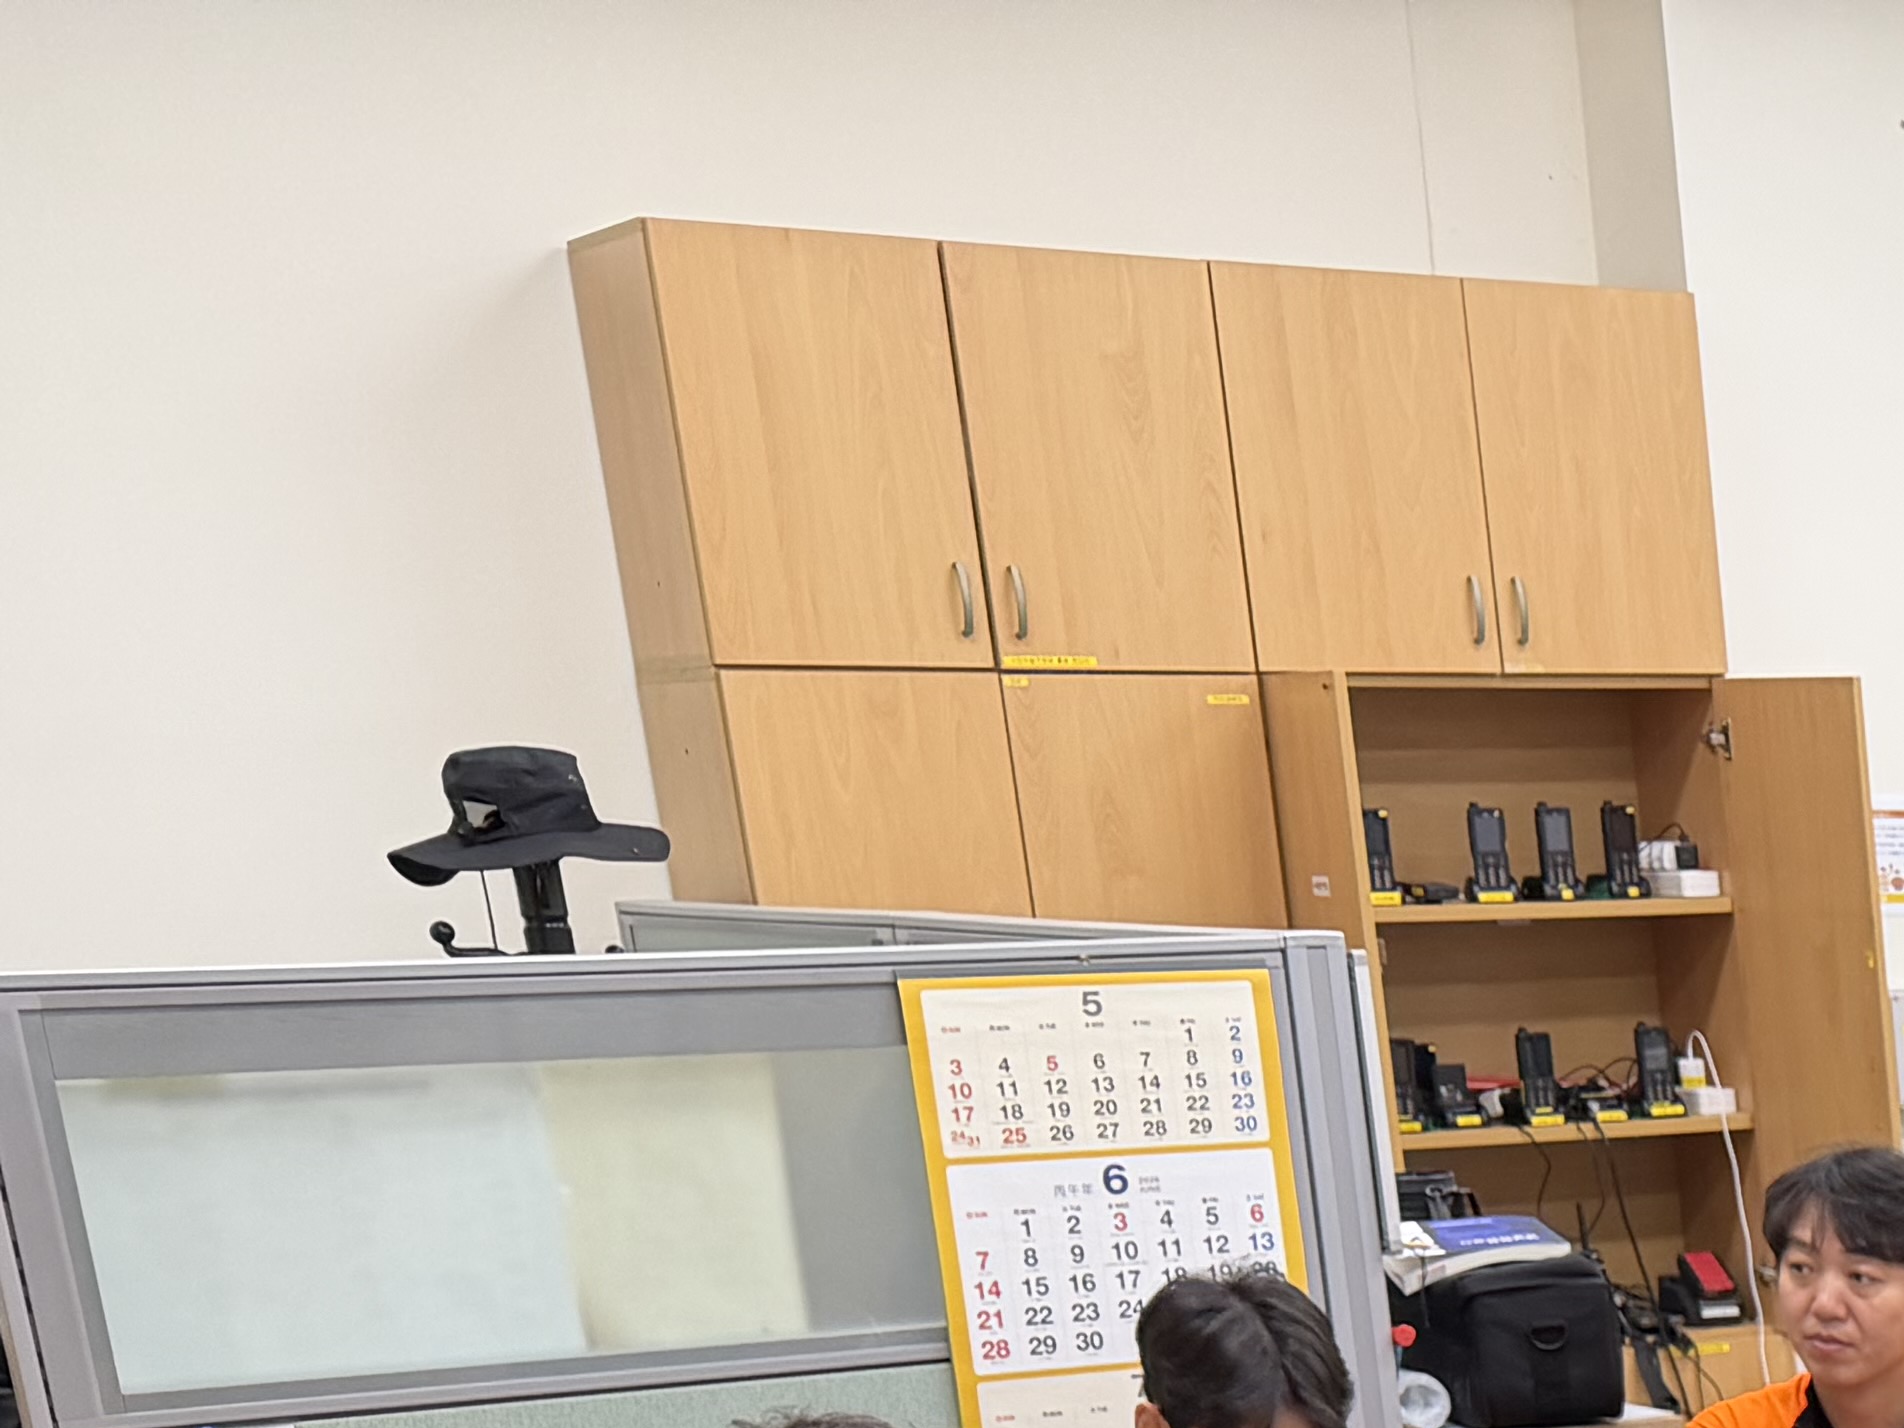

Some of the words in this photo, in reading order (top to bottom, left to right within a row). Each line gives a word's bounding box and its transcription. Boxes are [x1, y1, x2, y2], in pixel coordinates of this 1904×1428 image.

[1082, 992, 1102, 1016] 5
[1184, 1027, 1193, 1043] 1
[1229, 1025, 1241, 1042] 2
[949, 1058, 963, 1076] 3
[998, 1057, 1010, 1073] 4
[1046, 1055, 1059, 1072] 5
[1093, 1053, 1106, 1070] 6
[1139, 1051, 1151, 1068] 7
[1186, 1049, 1199, 1066] 8
[1231, 1048, 1244, 1064] 9
[948, 1082, 973, 1100] 10
[996, 1080, 1018, 1098] 11
[1043, 1078, 1069, 1095] 12
[1091, 1076, 1115, 1093] 13
[1138, 1074, 1161, 1091] 14
[1184, 1072, 1207, 1089] 15
[1230, 1070, 1253, 1087] 16
[951, 1105, 974, 1123] 17
[999, 1103, 1024, 1121] 18
[1047, 1101, 1071, 1118] 19
[1093, 1099, 1118, 1116] 20
[1139, 1097, 1162, 1114] 21
[1185, 1094, 1210, 1112] 22
[1231, 1092, 1256, 1110] 23
[1001, 1127, 1027, 1145] 25
[1049, 1124, 1075, 1142] 26
[1096, 1122, 1120, 1140] 27
[1142, 1119, 1168, 1137] 28
[1188, 1117, 1213, 1135] 29
[1234, 1115, 1258, 1132] 30
[1103, 1164, 1129, 1195] 6
[1020, 1218, 1031, 1238] 1
[1066, 1215, 1082, 1235] 2
[1113, 1212, 1128, 1232] 3
[1159, 1209, 1174, 1228] 4
[1205, 1206, 1220, 1226] 5
[1250, 1203, 1265, 1223] 6
[975, 1250, 990, 1271] 7
[1023, 1247, 1039, 1268] 8
[1070, 1244, 1085, 1264] 9
[1111, 1240, 1139, 1261] 10
[1157, 1238, 1182, 1258] 11
[1203, 1234, 1230, 1255] 12
[1248, 1231, 1275, 1251] 13
[974, 1280, 1002, 1301] 14
[1021, 1276, 1050, 1297] 15
[1068, 1273, 1097, 1294] 16
[1115, 1269, 1141, 1290] 17
[976, 1309, 1004, 1331] 21
[1024, 1305, 1054, 1327] 22
[1071, 1301, 1101, 1323] 23
[1118, 1300, 1144, 1320] 24
[981, 1339, 1011, 1361] 28
[1028, 1335, 1057, 1356] 29
[1075, 1331, 1104, 1352] 30
